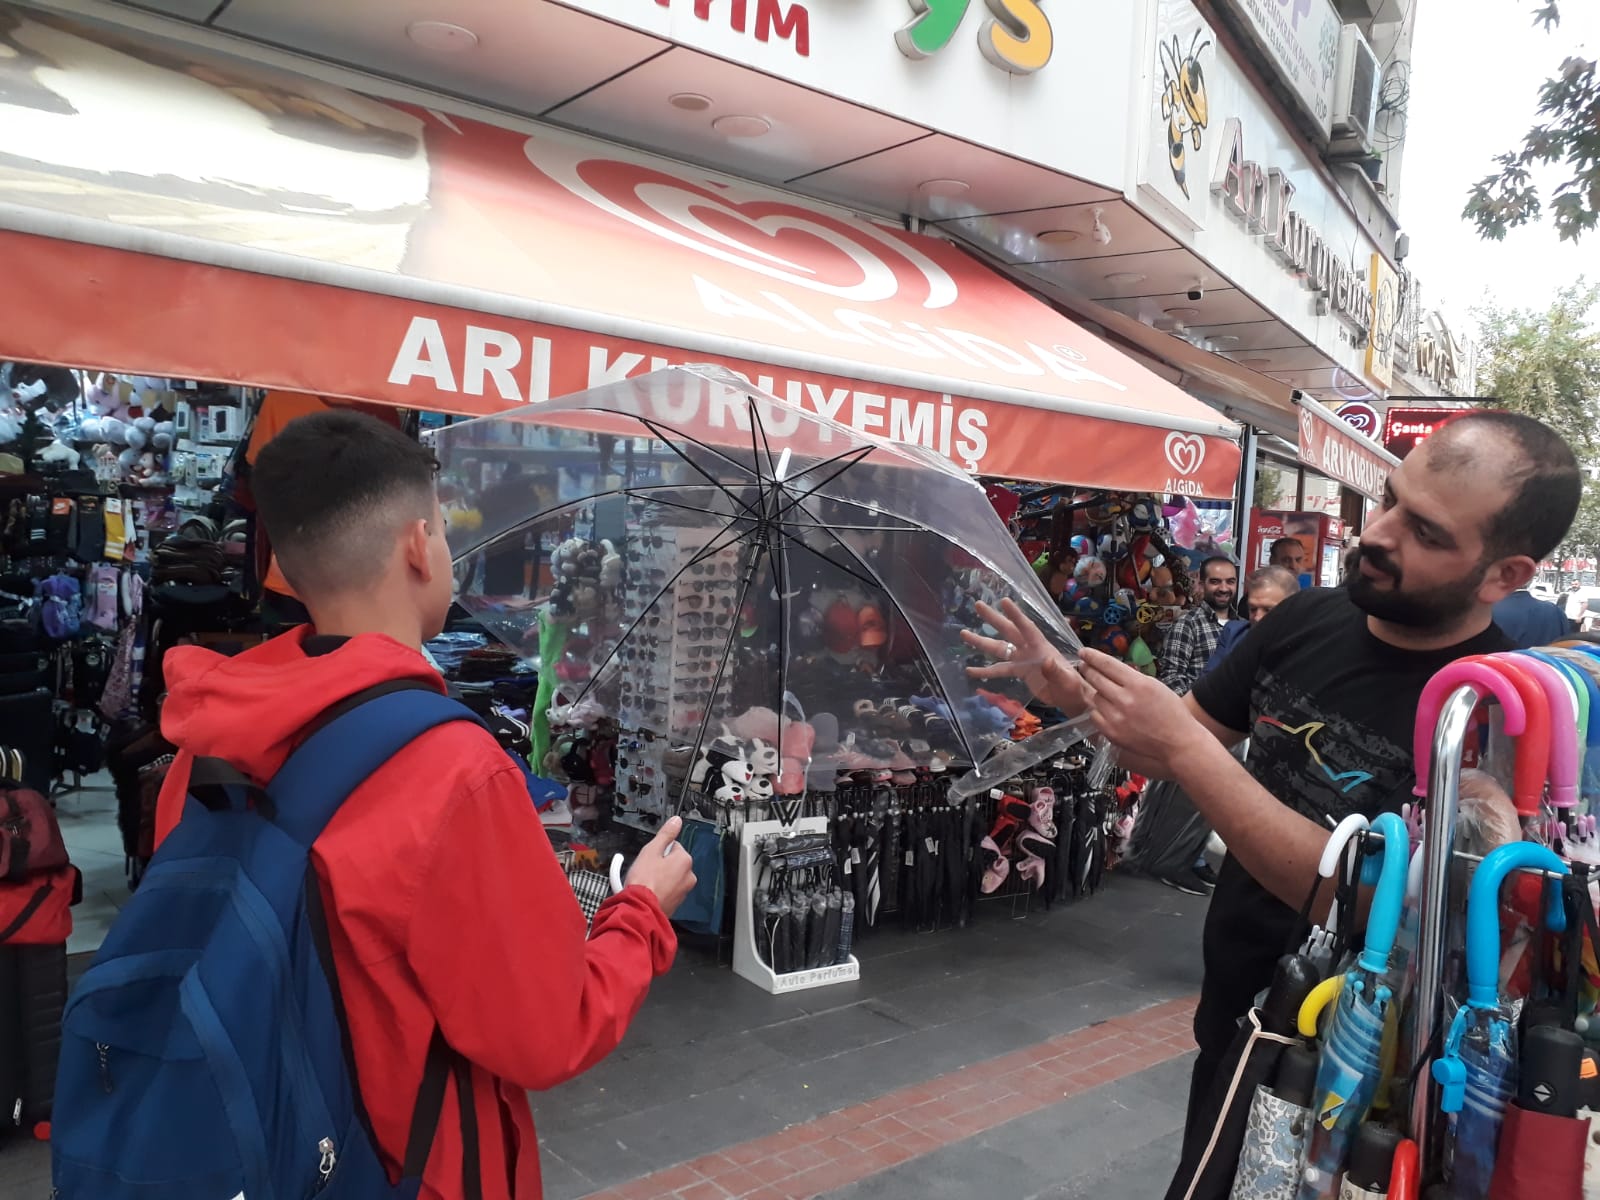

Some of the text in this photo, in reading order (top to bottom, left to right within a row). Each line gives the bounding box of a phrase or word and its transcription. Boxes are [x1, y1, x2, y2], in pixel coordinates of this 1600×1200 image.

[387, 316, 989, 474] ARI KURUYEMİŞ
[1322, 435, 1345, 478] ARI
